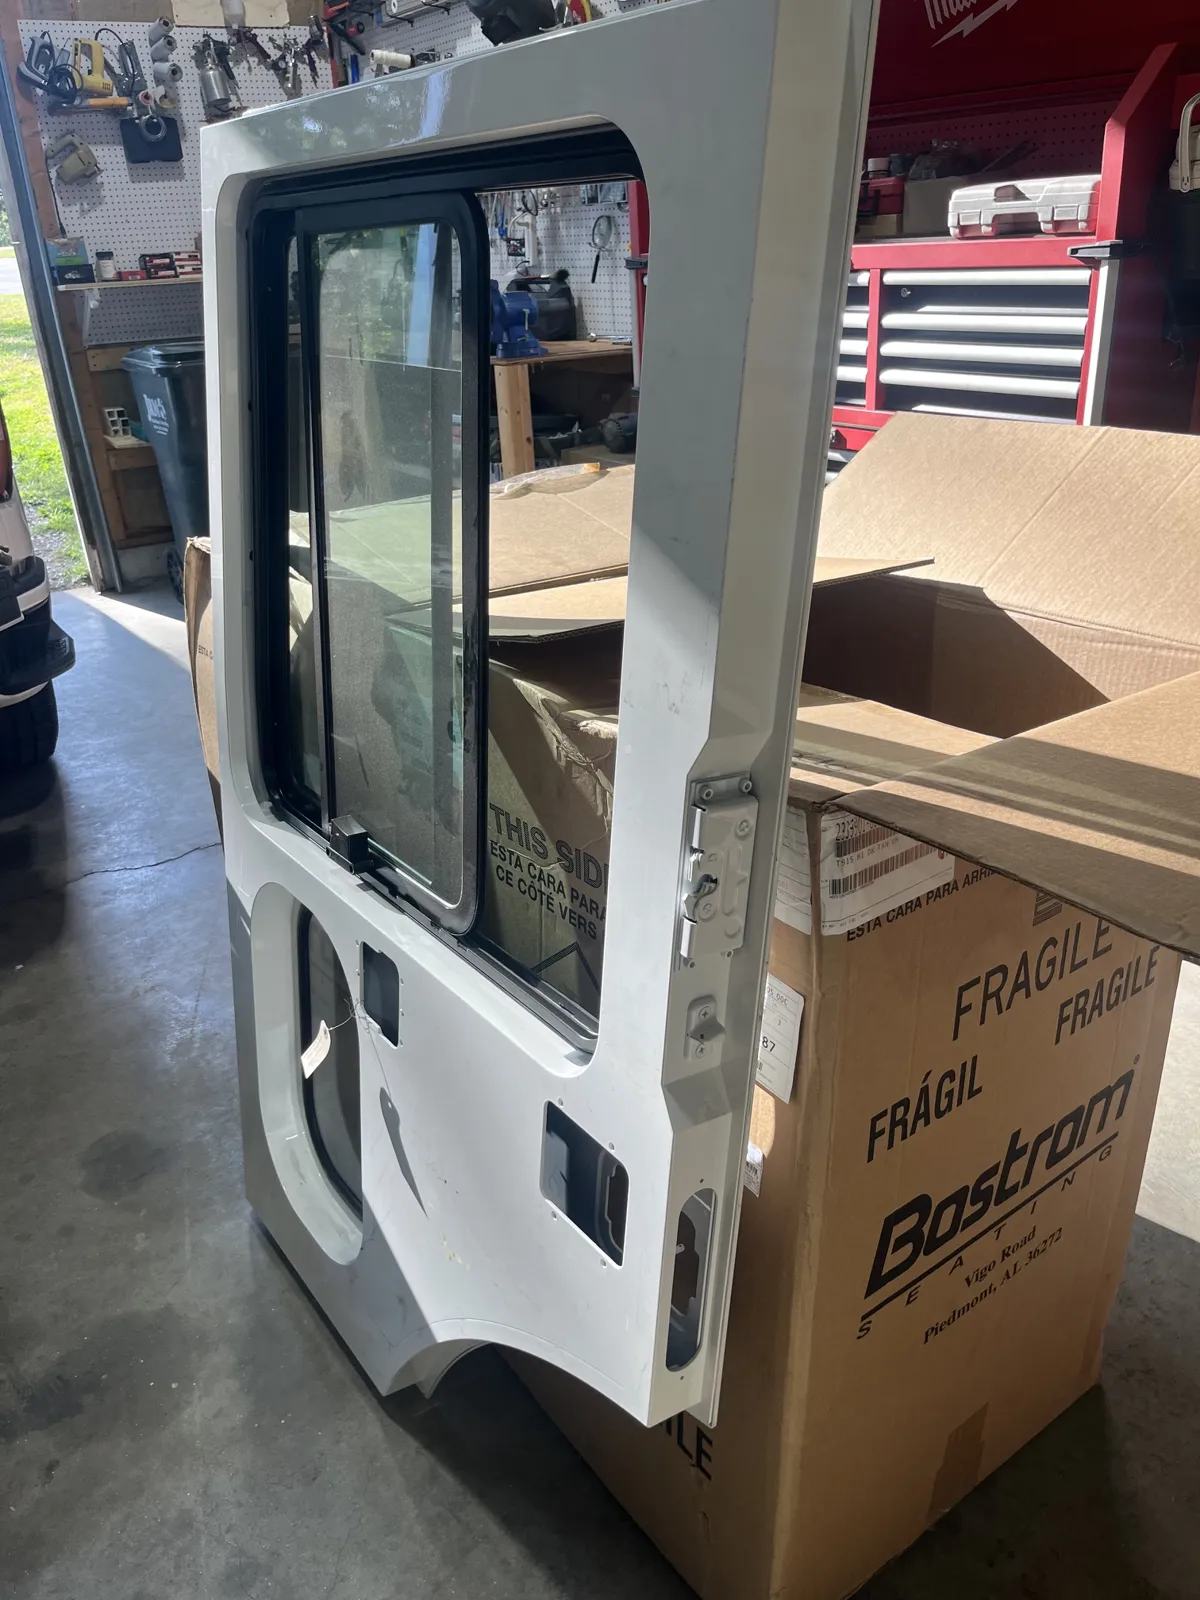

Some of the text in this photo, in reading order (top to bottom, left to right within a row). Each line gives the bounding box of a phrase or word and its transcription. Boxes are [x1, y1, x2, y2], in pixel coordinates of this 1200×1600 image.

[489, 803, 609, 895] THIS SID
[490, 840, 524, 873] ESTA
[528, 863, 567, 898] CARA
[496, 865, 597, 940] CE CÔTÉ VERS
[846, 916, 883, 942] ESTA
[886, 899, 922, 923] CARA
[926, 878, 958, 906] PARA
[952, 918, 1112, 1041] FRAGILE
[1054, 945, 1160, 1045] FRAGILE
[866, 1055, 983, 1163] FRÁGIL
[864, 1069, 1135, 1300] Bostrom
[923, 1227, 1063, 1344] Piedmont, AL 36272
[964, 1225, 1037, 1288] Vigo Road
